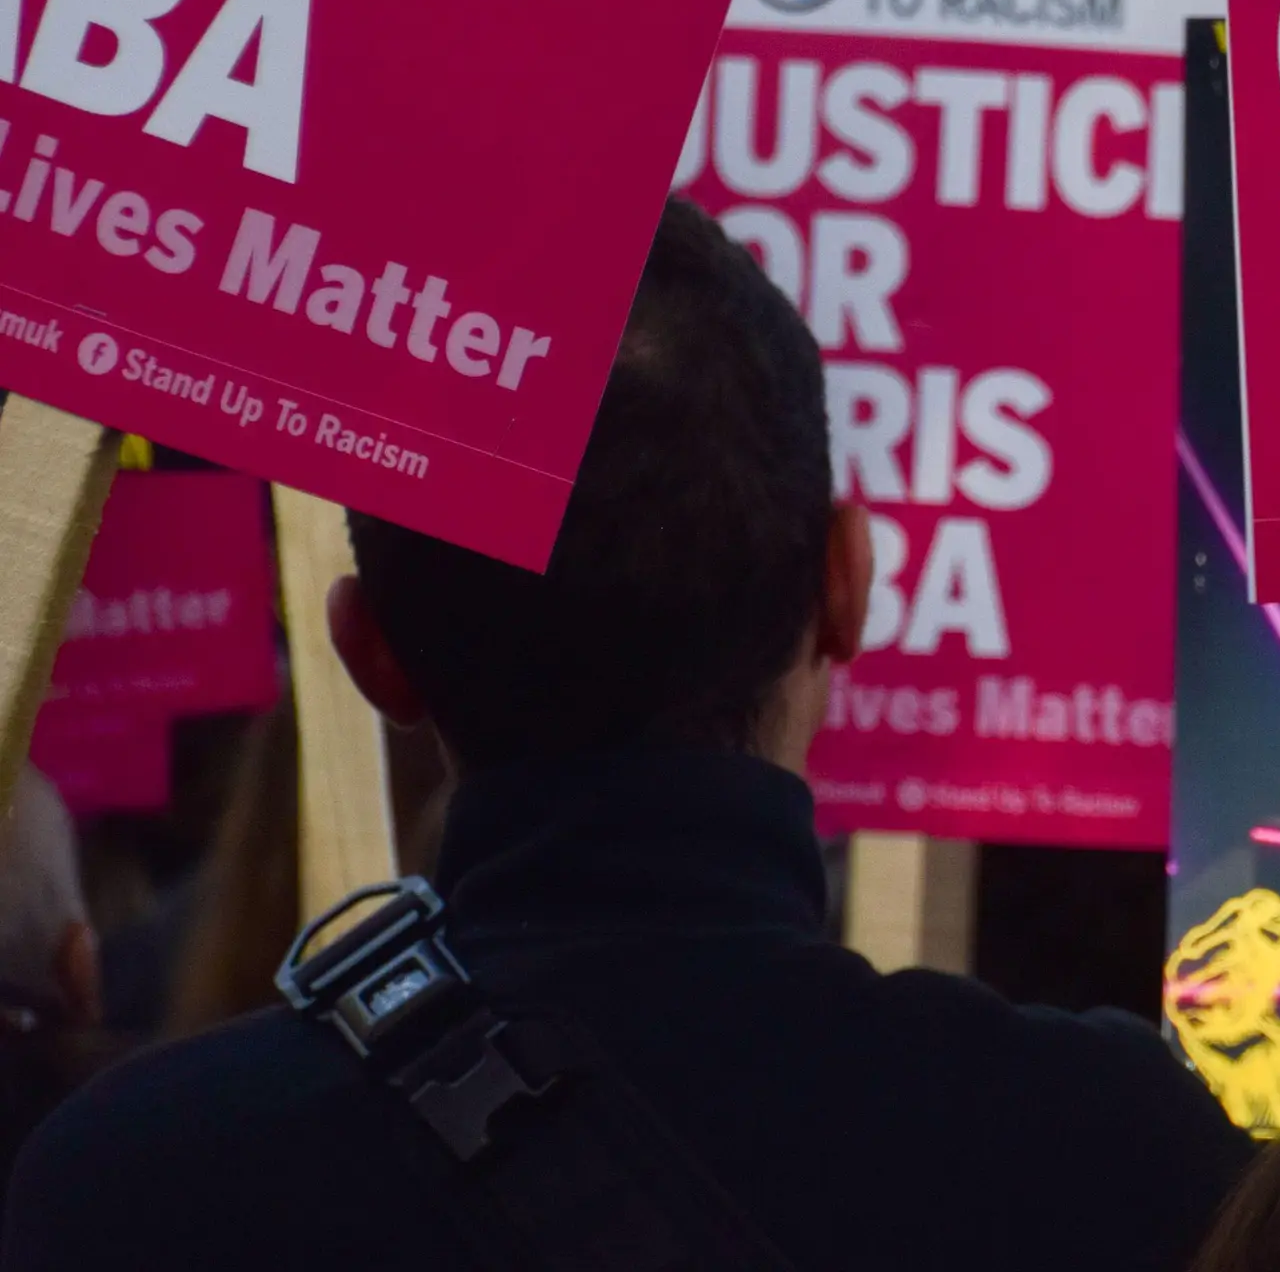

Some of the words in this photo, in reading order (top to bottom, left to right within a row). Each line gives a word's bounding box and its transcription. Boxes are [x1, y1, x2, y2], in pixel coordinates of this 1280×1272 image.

[0, 116, 205, 275] ives
[219, 206, 552, 392] Matter
[121, 347, 215, 405] Stand
[220, 380, 264, 427] Up
[277, 398, 307, 437] To
[314, 414, 430, 479] Racism
